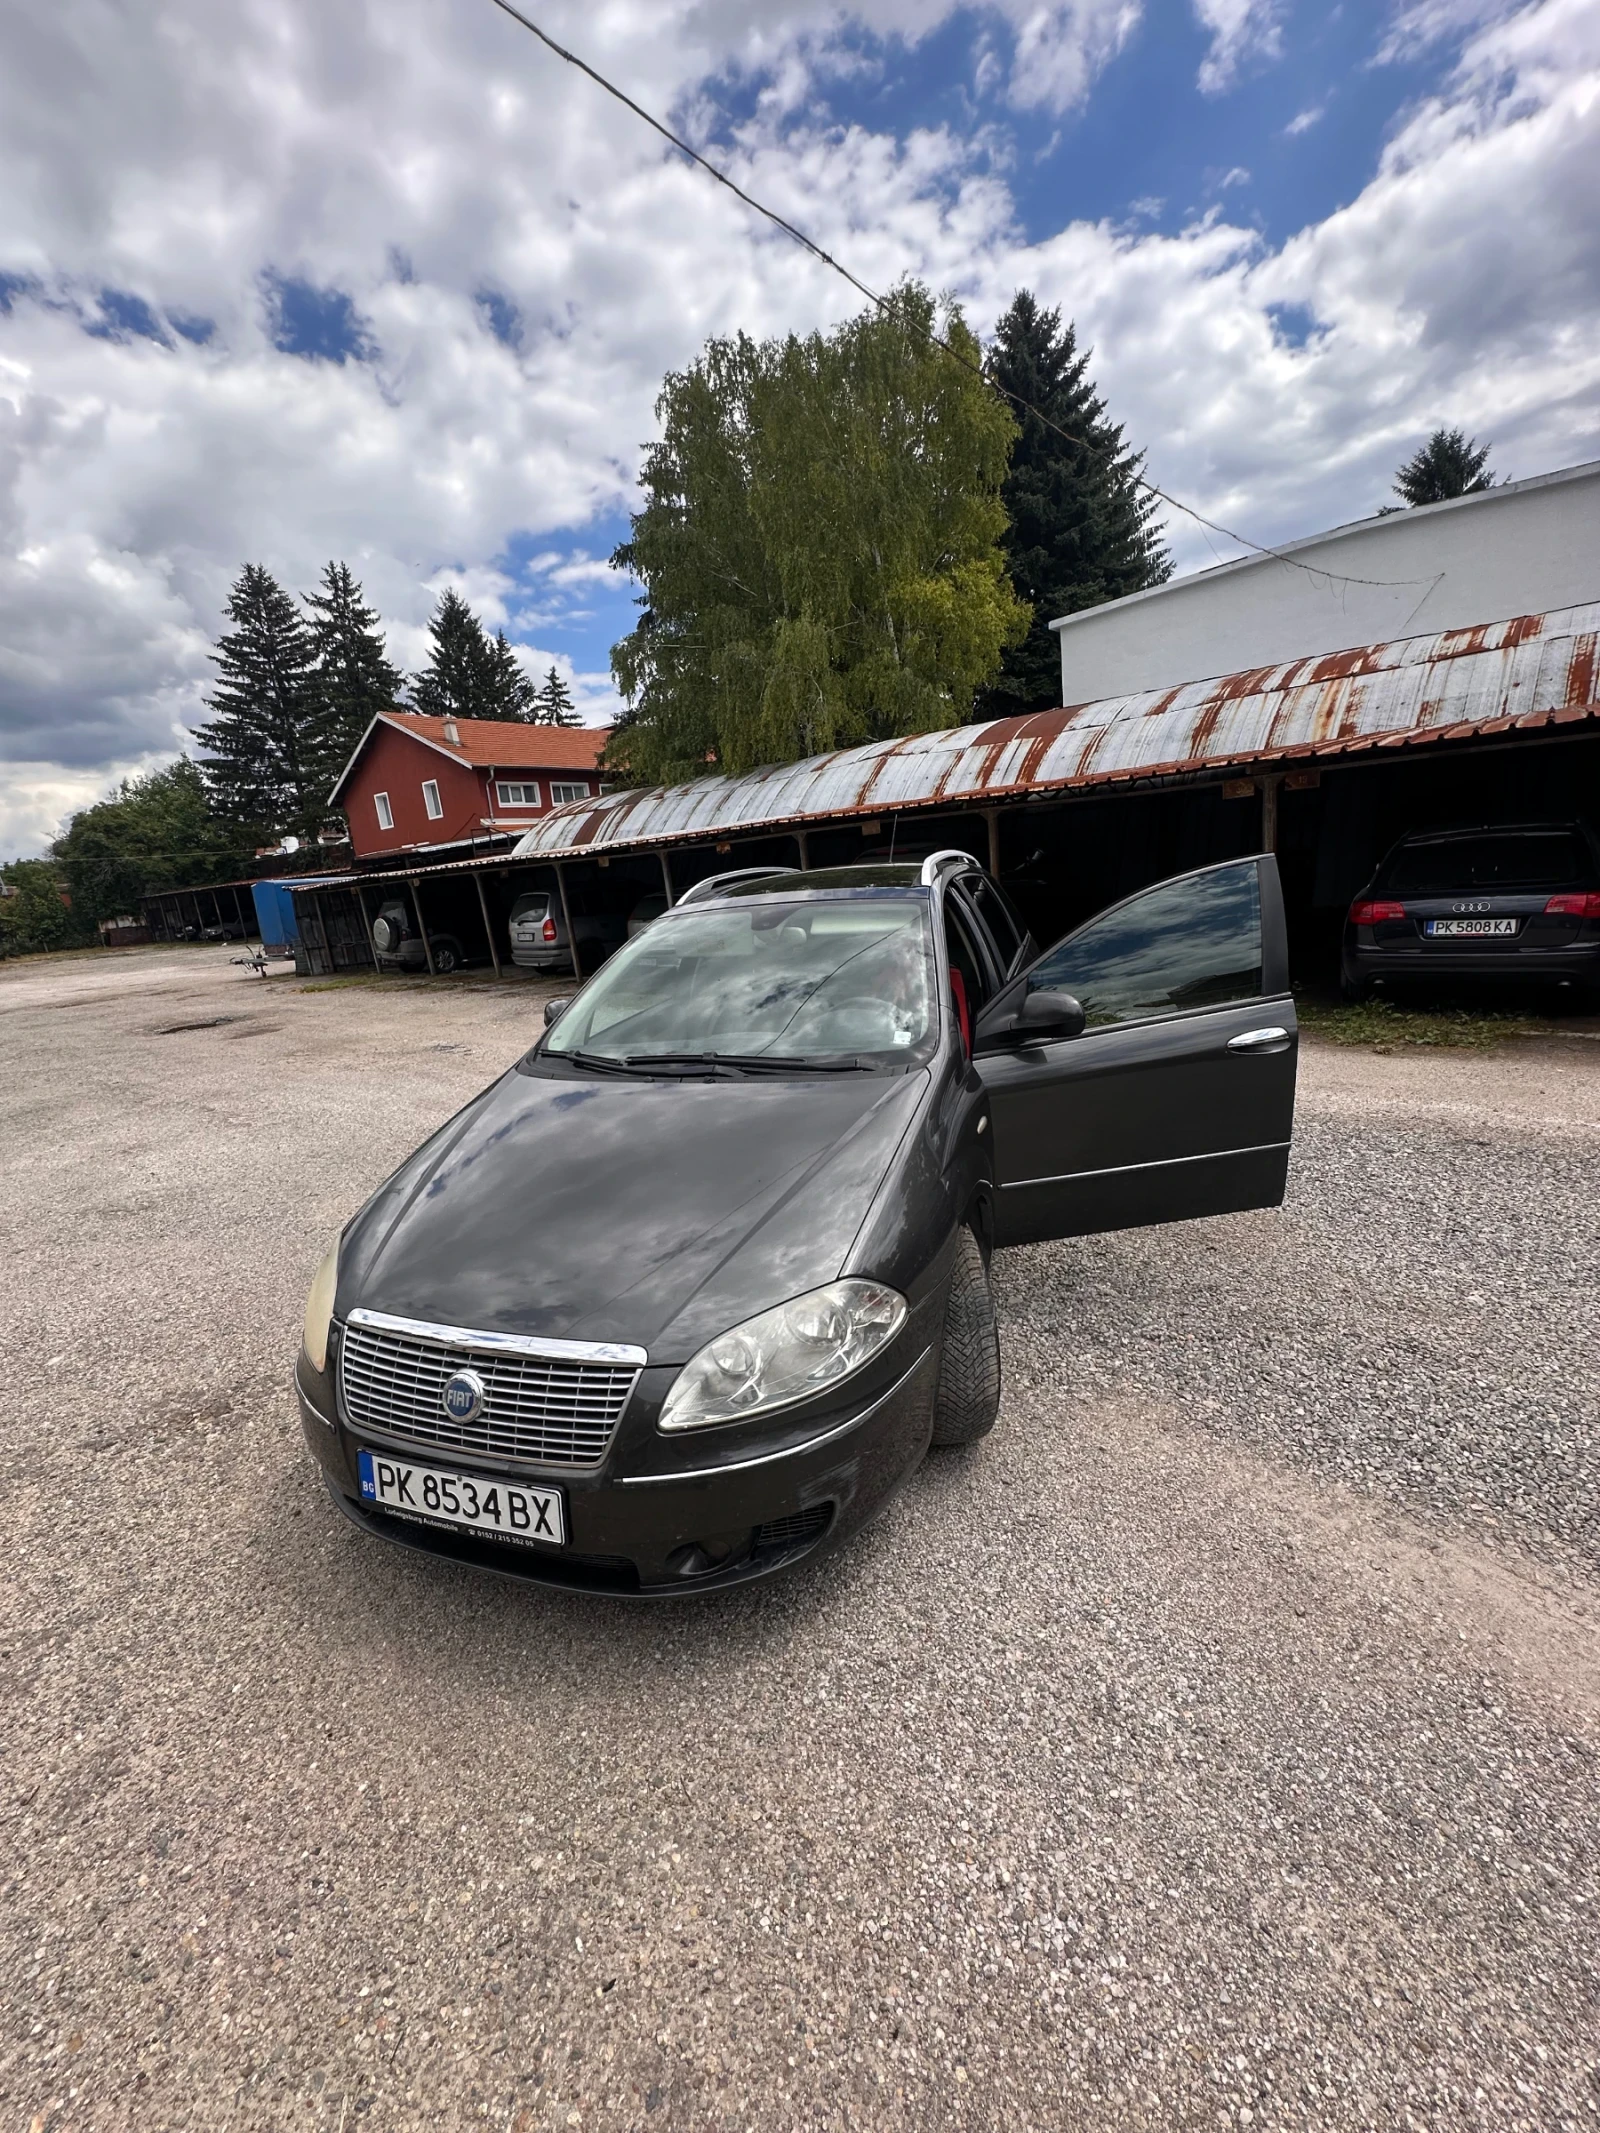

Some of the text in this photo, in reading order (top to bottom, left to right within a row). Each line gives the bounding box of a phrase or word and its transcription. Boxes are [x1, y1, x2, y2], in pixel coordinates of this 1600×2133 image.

[1435, 921, 1453, 933] PK
[1456, 921, 1491, 933] 5808
[1494, 921, 1513, 933] KA
[447, 1389, 473, 1408] FIAT
[362, 1481, 375, 1493] BG
[377, 1462, 555, 1536] PK 8534 BX
[423, 1517, 459, 1532] Automobile
